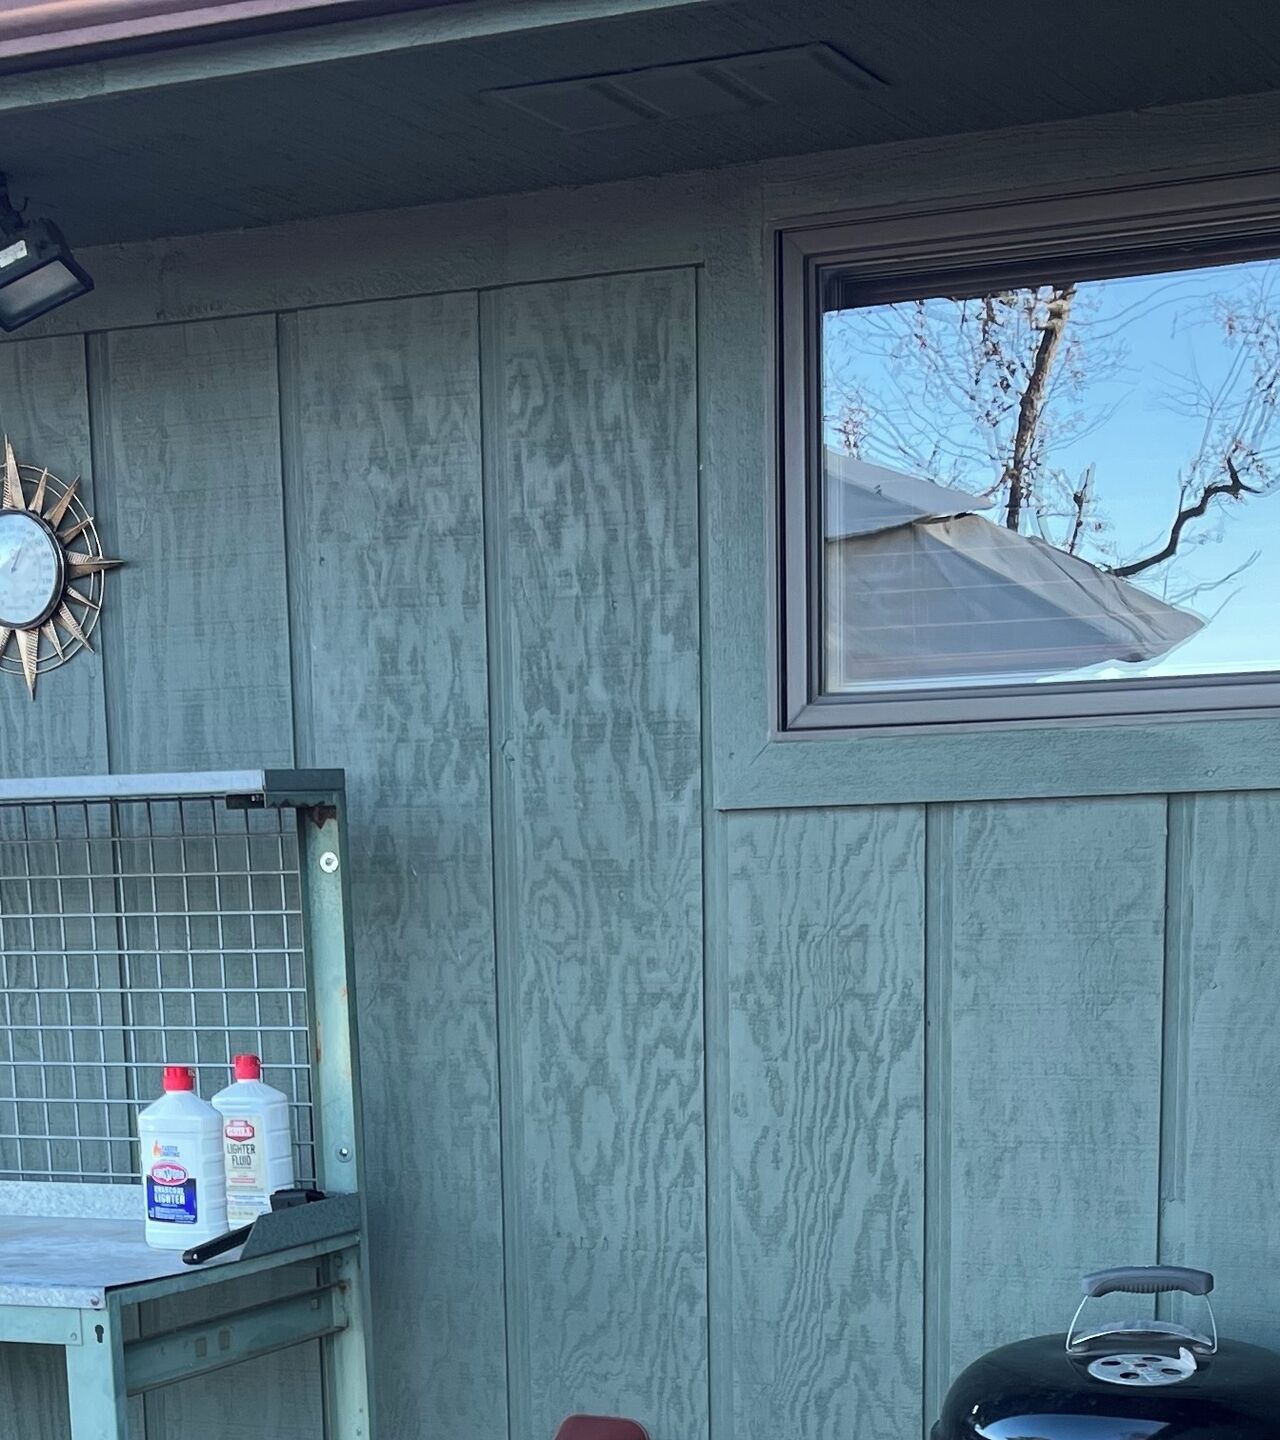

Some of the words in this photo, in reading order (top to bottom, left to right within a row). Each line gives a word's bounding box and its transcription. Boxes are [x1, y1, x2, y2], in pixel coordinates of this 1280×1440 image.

[226, 1143, 256, 1154] LIGHTER
[231, 1154, 252, 1166] FLUID
[154, 1193, 186, 1205] LIGHTER
